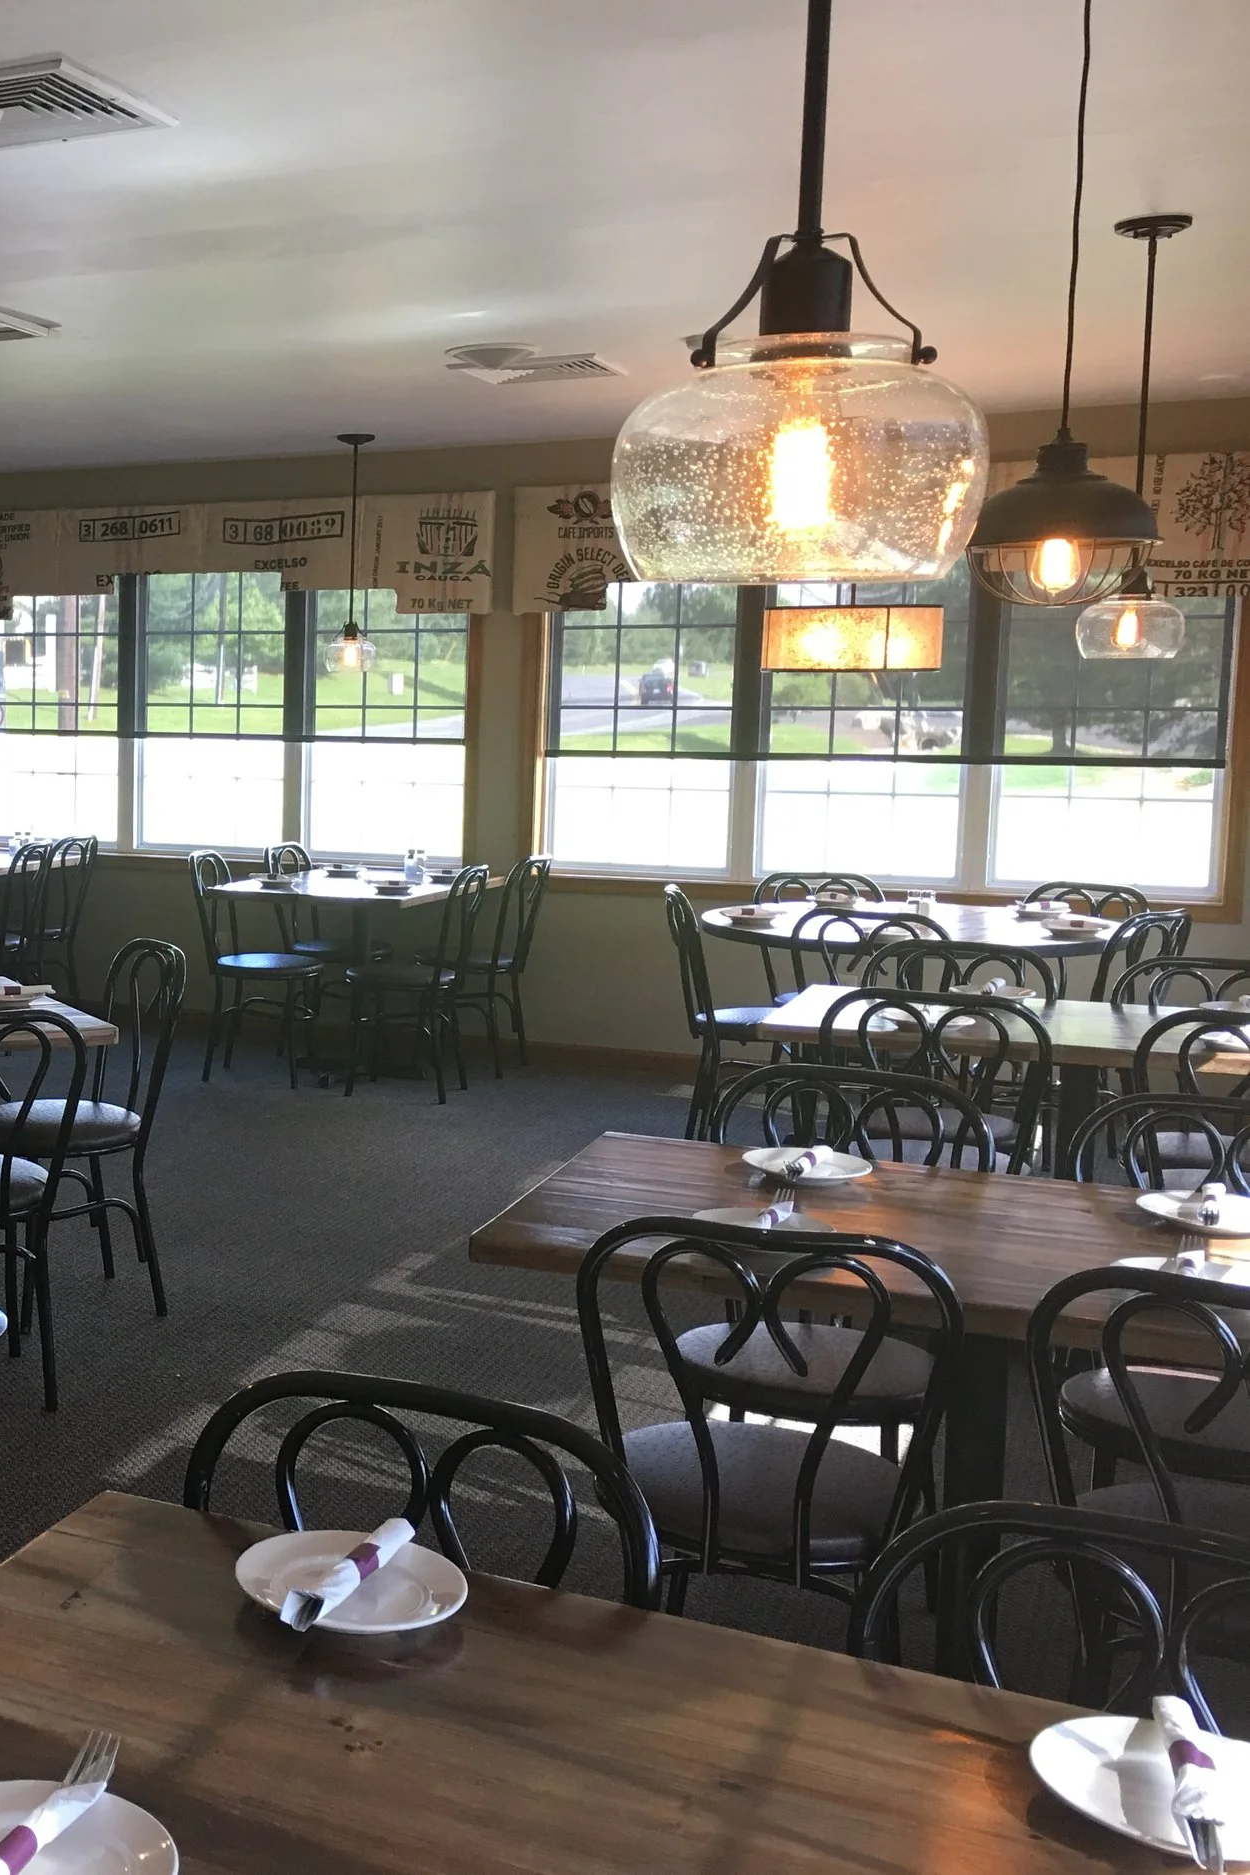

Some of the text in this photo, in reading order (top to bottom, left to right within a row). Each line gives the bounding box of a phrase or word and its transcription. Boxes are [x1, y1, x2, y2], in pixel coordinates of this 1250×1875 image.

[83, 517, 173, 537] 3 268 0611
[229, 523, 239, 540] 3
[253, 524, 274, 541] 68
[558, 526, 615, 539] CAFE IMPORTS
[4, 532, 30, 542] UNION
[254, 557, 308, 570] EXCELSO
[547, 552, 576, 589] ORIGIN
[576, 546, 617, 567] SELECT
[1220, 559, 1233, 568] DE
[414, 574, 473, 582] CAUCA
[1173, 569, 1192, 579] 70
[1197, 569, 1221, 579] KG
[1174, 586, 1209, 597] 323
[410, 598, 474, 611] 70 Kg NET
